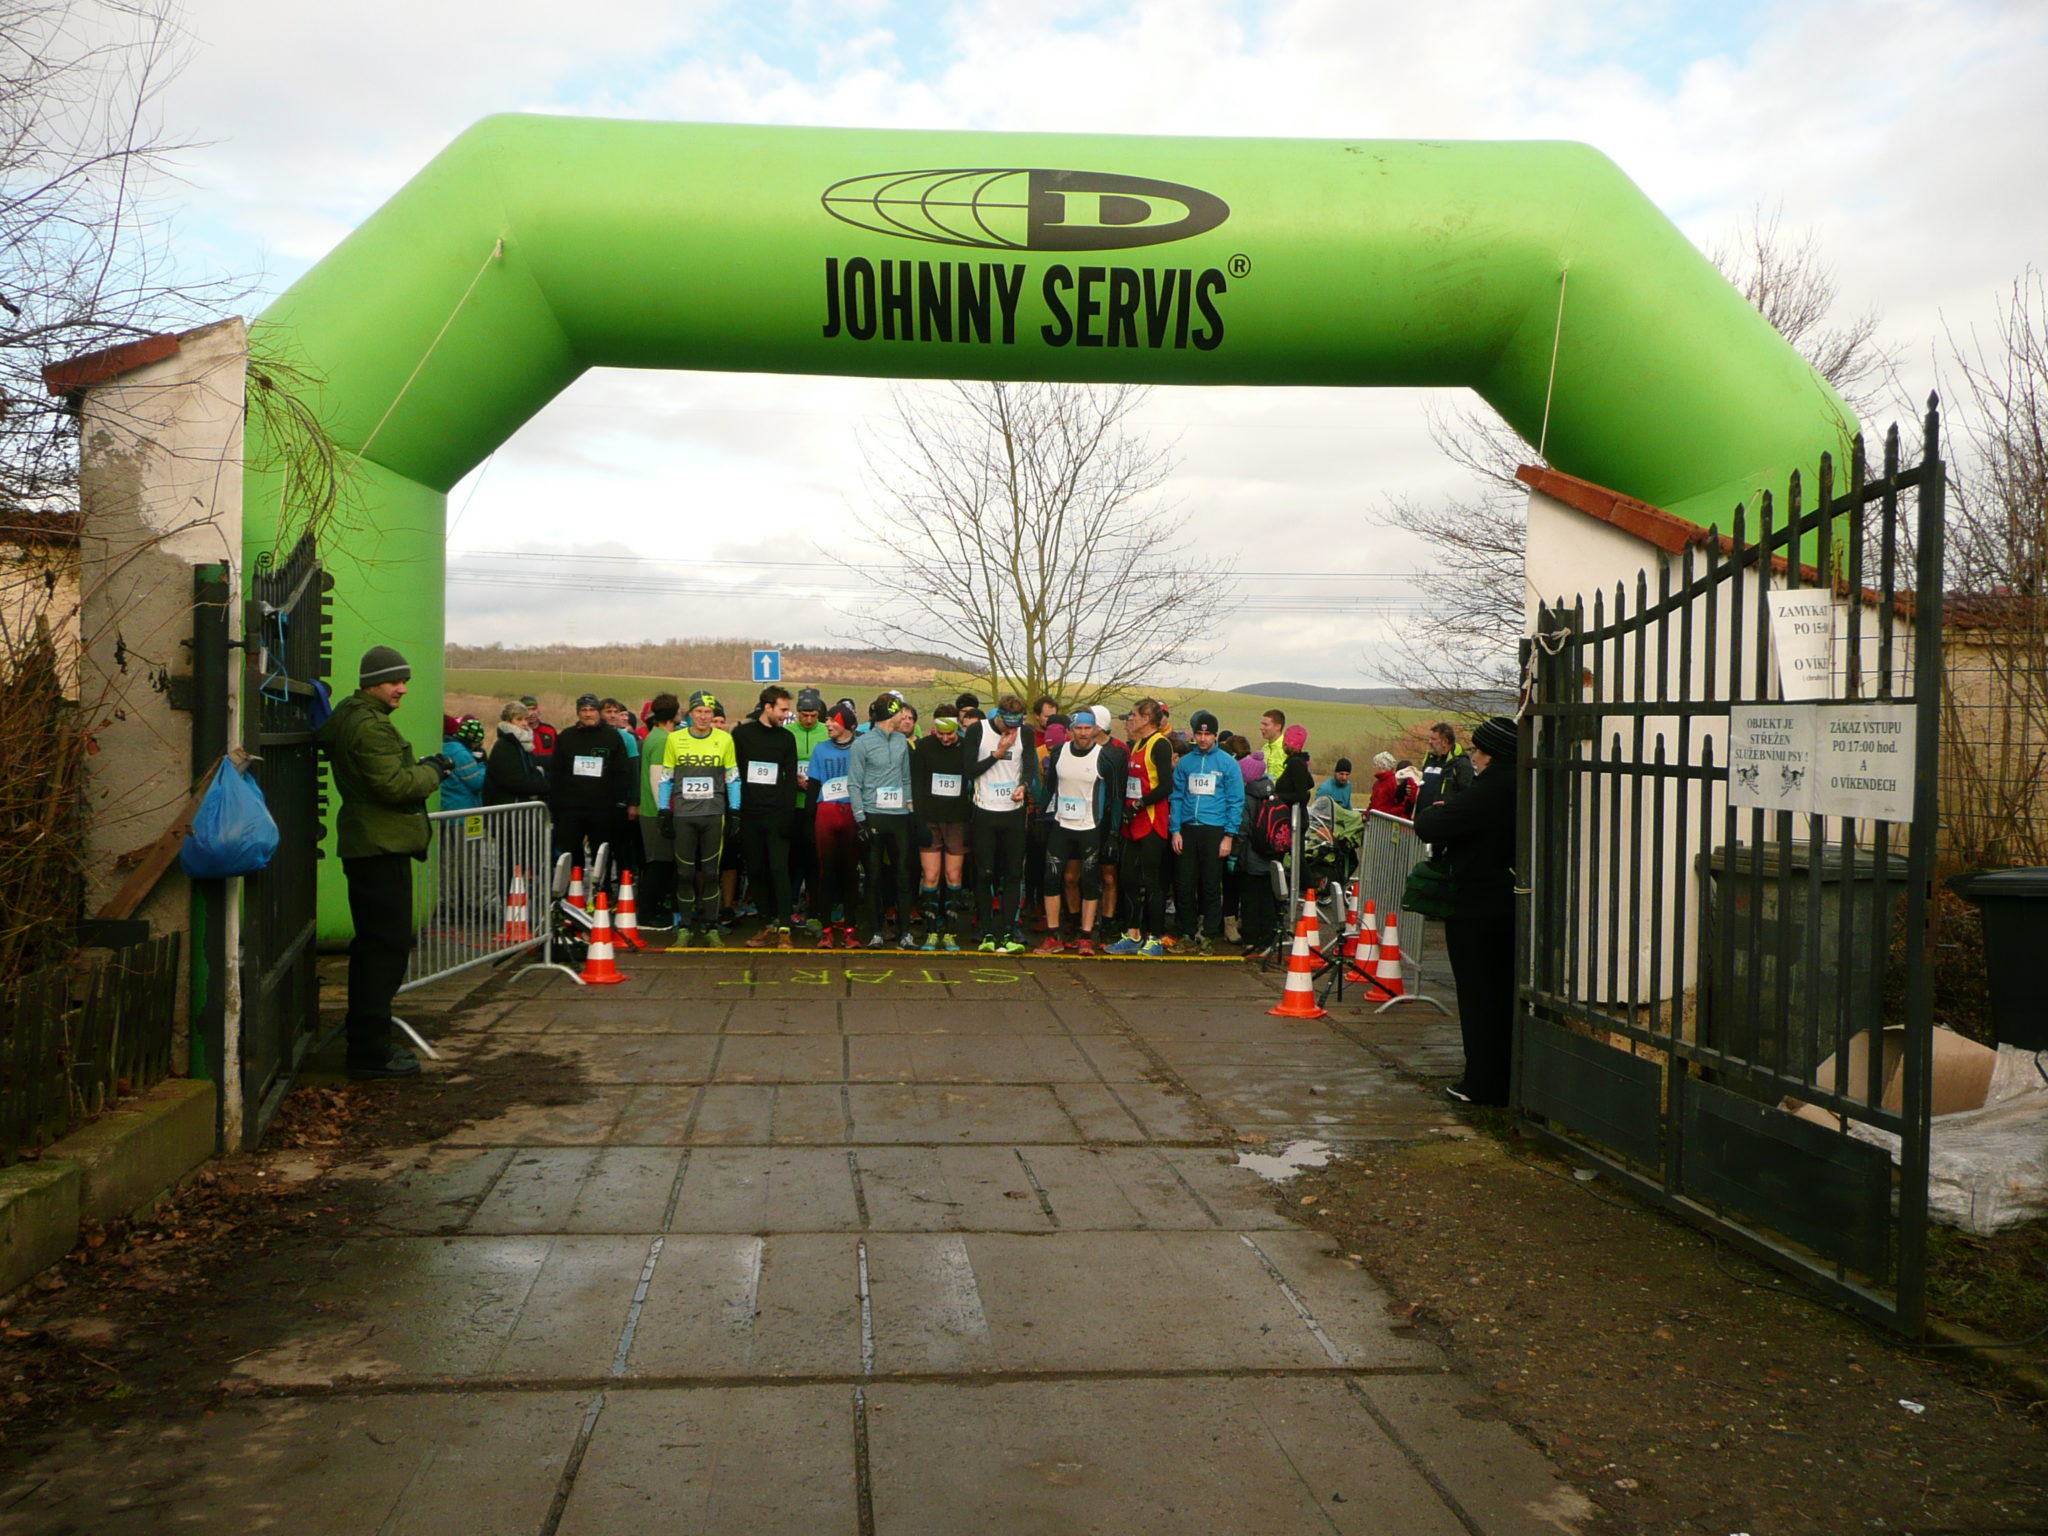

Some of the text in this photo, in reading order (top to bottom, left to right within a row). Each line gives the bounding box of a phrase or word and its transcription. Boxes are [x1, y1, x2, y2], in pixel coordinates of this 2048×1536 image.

[822, 256, 1026, 344] JOHNNY
[1040, 263, 1228, 351] SERVIS
[1794, 622, 1810, 635] PO
[1794, 658, 1804, 671] O
[1746, 718, 1794, 729] OBJEKT JE
[1830, 718, 1902, 734] ZÁKAZ VSTUPU
[1750, 731, 1791, 745] STŘEŽEN
[1832, 740, 1898, 753] PO 17:00 hod.
[1735, 746, 1786, 761] SLUŽEBNÍMI
[1860, 759, 1867, 771] A
[757, 767, 769, 777] 89
[686, 782, 710, 792] 229
[831, 783, 842, 792] 52
[938, 779, 955, 789] 183
[1194, 779, 1209, 787] 104
[1831, 774, 1896, 791] O VÍKENDECH
[883, 792, 898, 801] 210
[995, 787, 1011, 797] 105
[1065, 803, 1076, 812] 94
[718, 968, 1035, 985] START
